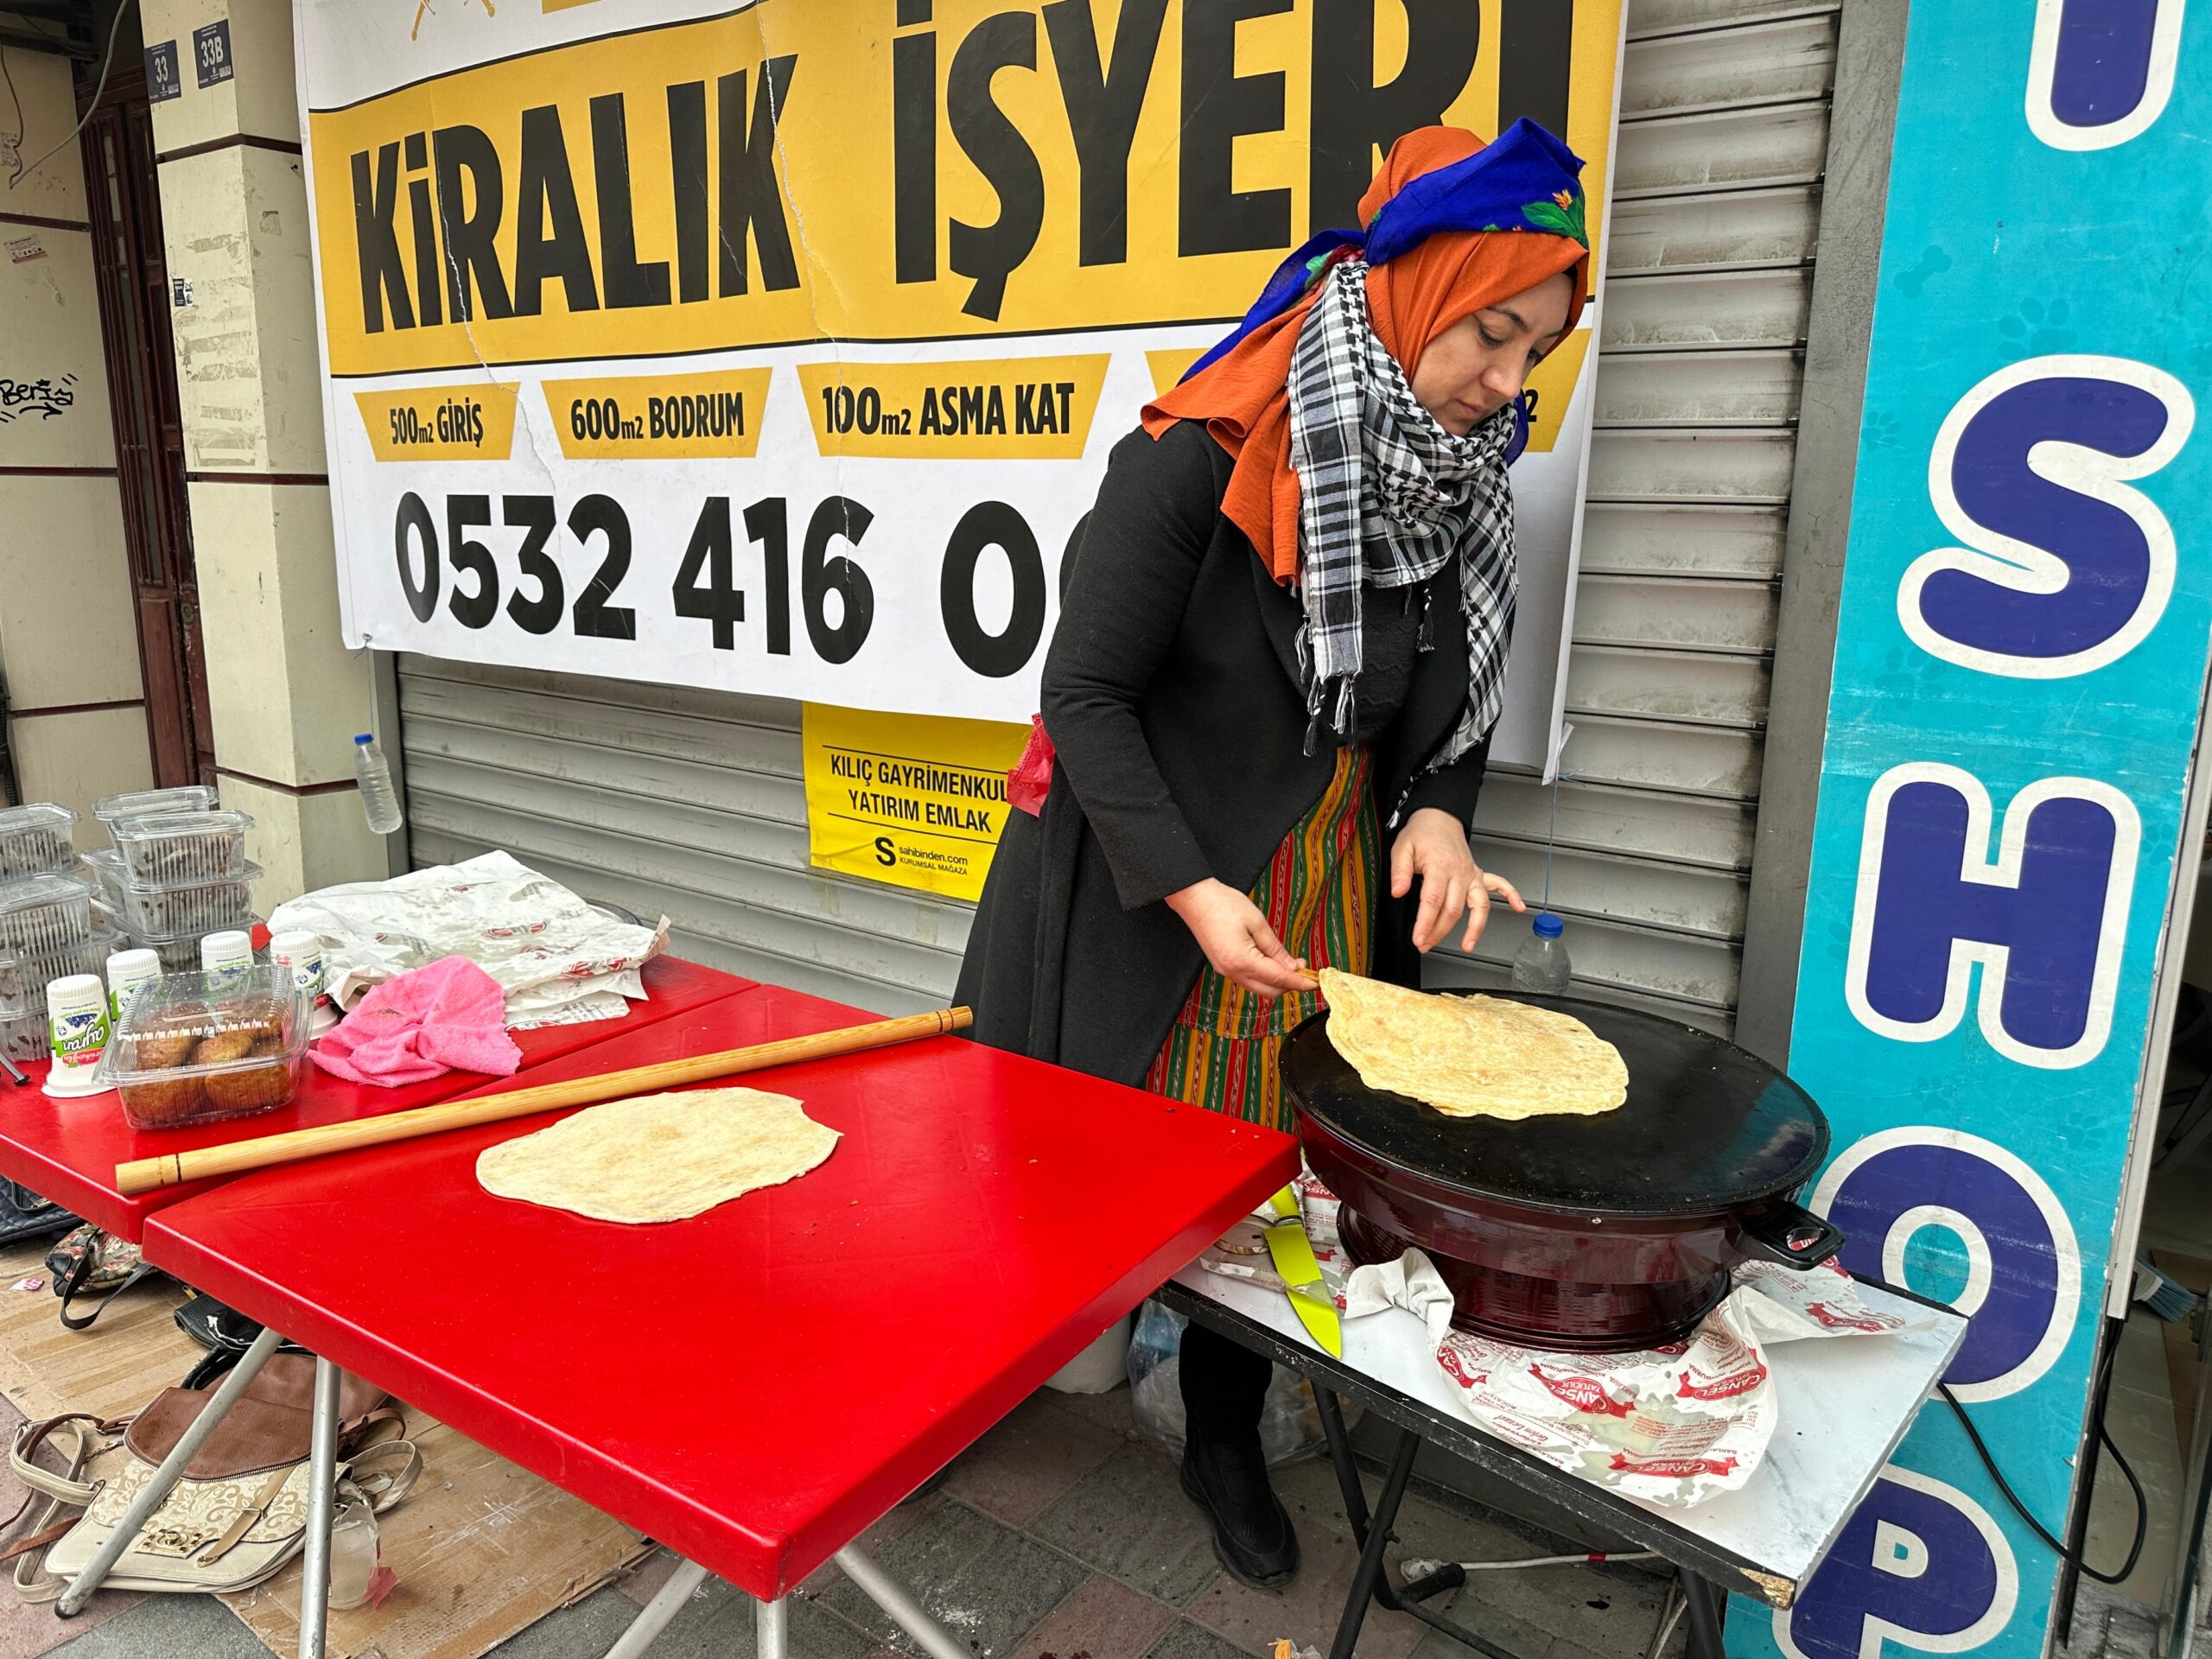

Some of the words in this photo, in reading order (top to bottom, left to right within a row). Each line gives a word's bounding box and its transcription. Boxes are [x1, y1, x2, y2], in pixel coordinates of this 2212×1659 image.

[155, 55, 168, 83] 33
[200, 35, 224, 68] 33B
[390, 407, 434, 445] 500m2
[436, 397, 484, 448] GİRİŞ
[570, 397, 645, 441] 600m2
[648, 391, 745, 439] BODRUM
[823, 385, 912, 436] 100m2
[918, 385, 1007, 436] ASMA
[1014, 382, 1075, 435] KAT
[395, 491, 637, 641] 0532
[671, 495, 874, 665] 416
[940, 499, 1094, 678] 0
[830, 753, 873, 786] KILIÇ
[878, 761, 1007, 803] GAYRİMENKUL
[848, 788, 920, 823] YATIRIM
[925, 802, 992, 834] EMLAK
[899, 844, 969, 866] sahibinden.com
[899, 856, 937, 871] KURUMSAL
[944, 863, 968, 876] MAĞAZA
[62, 1021, 105, 1052] ayran
[1700, 1373, 1760, 1397] CANSEL
